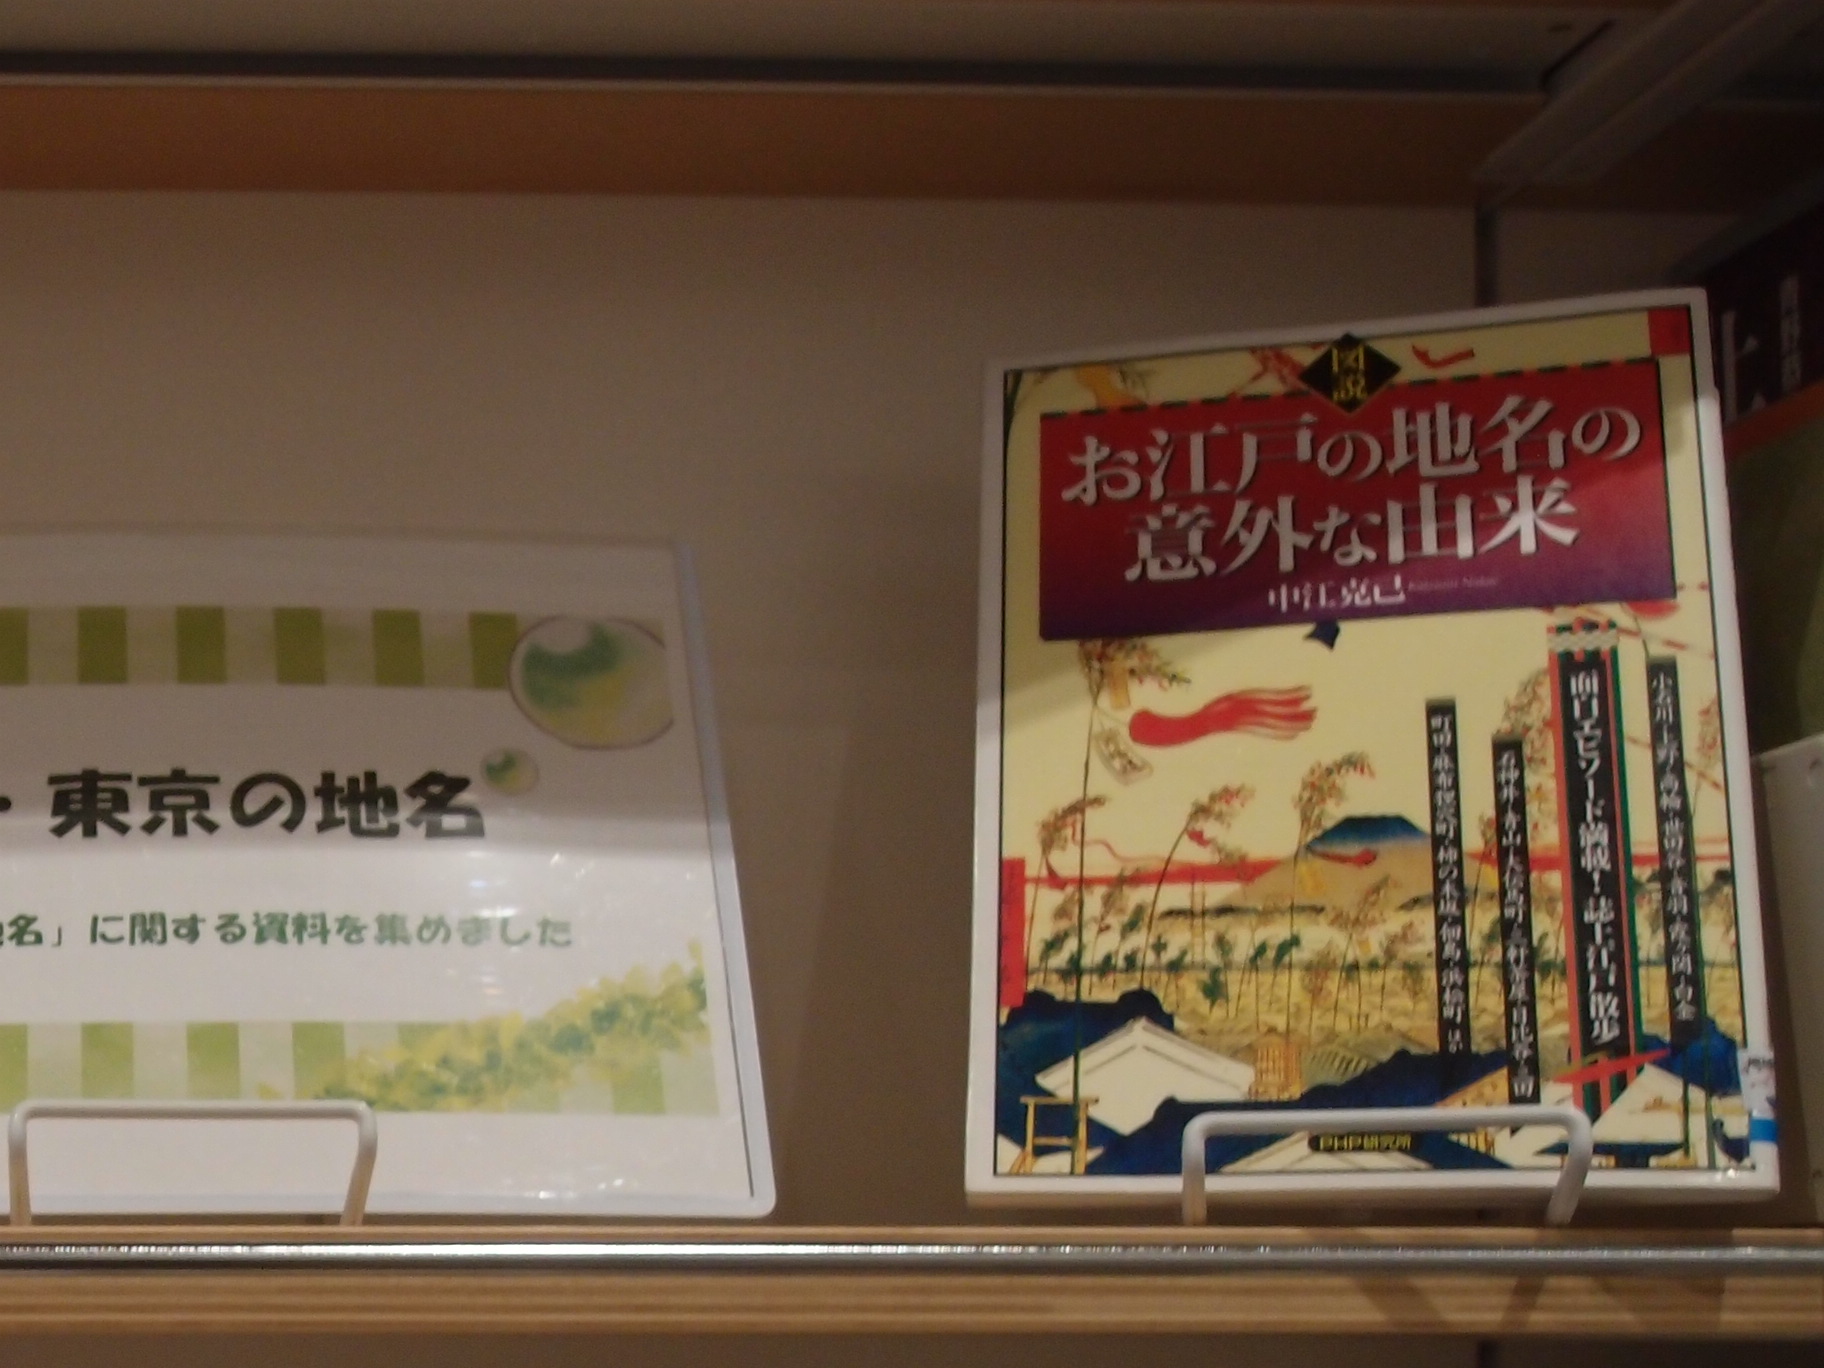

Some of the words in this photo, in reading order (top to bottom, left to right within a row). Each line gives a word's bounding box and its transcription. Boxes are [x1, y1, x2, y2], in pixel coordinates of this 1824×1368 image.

[1062, 395, 1641, 505] お江戸の地名の
[1125, 476, 1579, 582] 意外な由来
